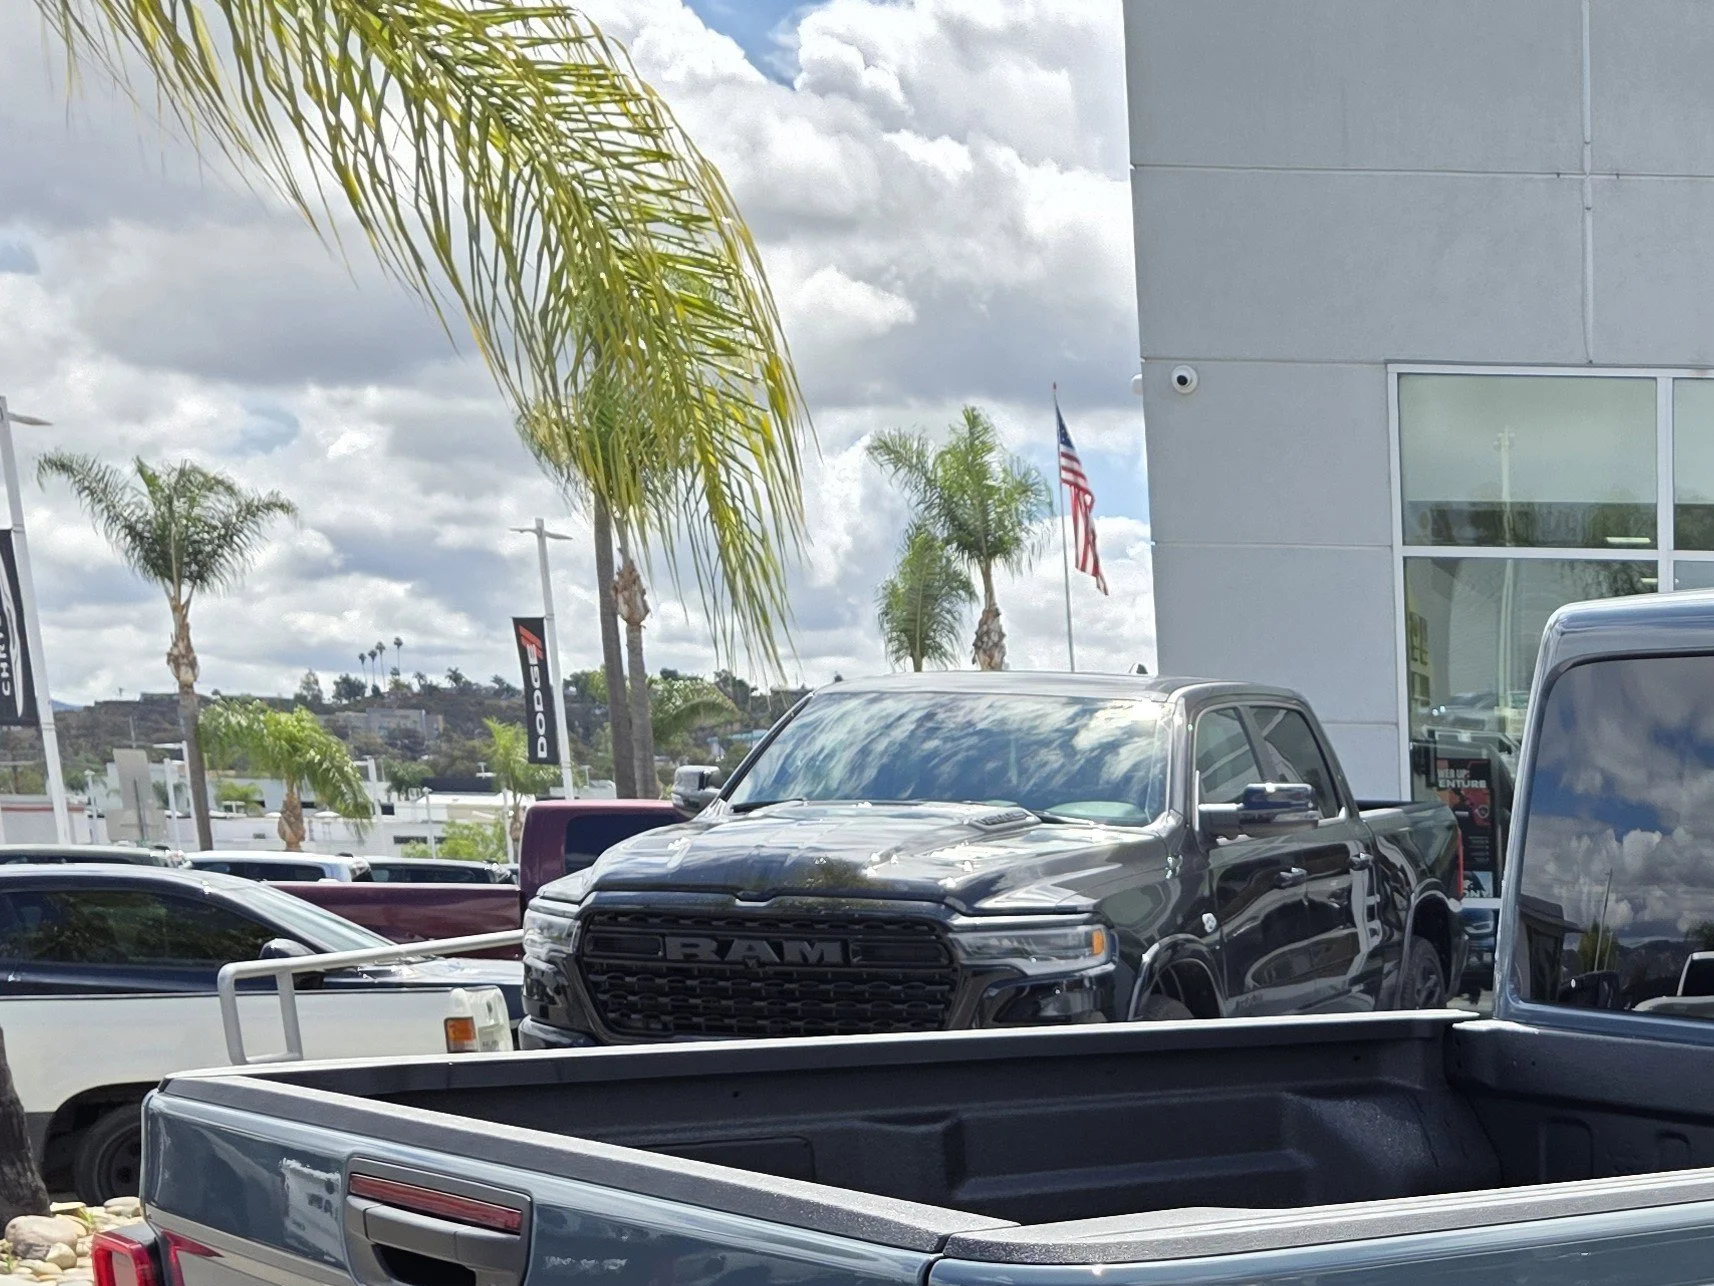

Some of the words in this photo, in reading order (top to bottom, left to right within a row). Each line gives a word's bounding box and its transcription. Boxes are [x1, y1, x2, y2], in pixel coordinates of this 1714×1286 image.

[527, 643, 547, 758] DODGE
[1438, 779, 1487, 788] ENTURE
[663, 936, 850, 966] RAM
